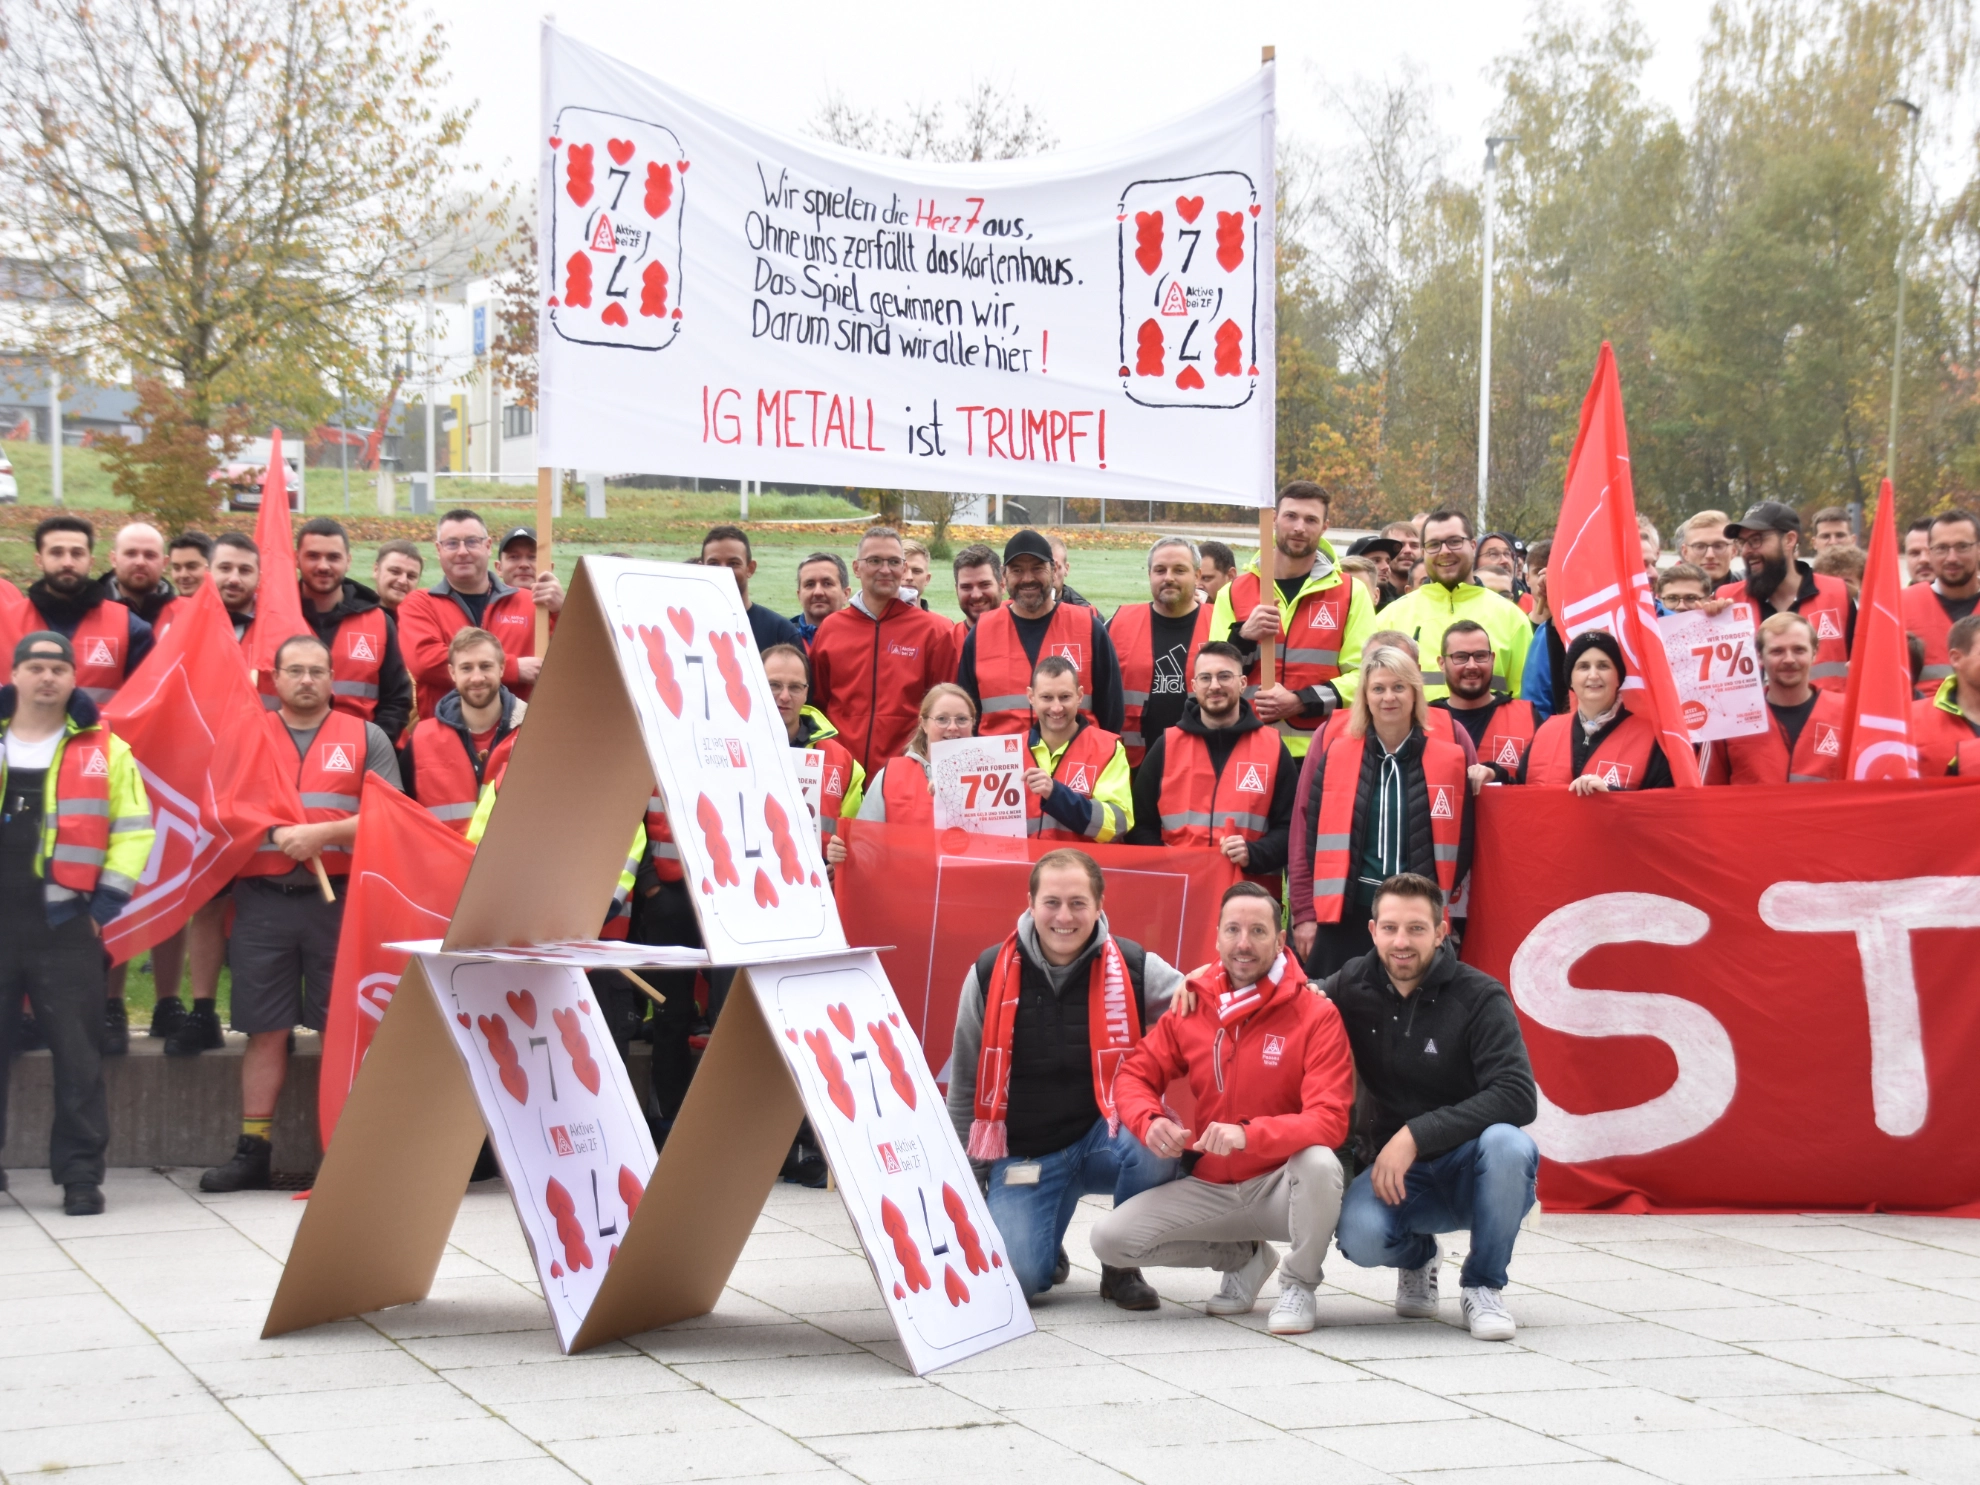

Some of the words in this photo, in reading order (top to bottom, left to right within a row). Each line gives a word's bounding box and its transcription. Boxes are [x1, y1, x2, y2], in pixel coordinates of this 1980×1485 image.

[607, 166, 631, 211] 7
[757, 161, 800, 209] Wir
[803, 186, 876, 232] spielen
[882, 193, 909, 226] die
[915, 198, 961, 233] Herz
[965, 197, 984, 234] 7
[982, 218, 1033, 240] aus,
[614, 236, 628, 247] bei
[629, 236, 641, 248] ZF
[615, 224, 642, 239] Aktive
[745, 211, 800, 258] Ohne
[804, 234, 838, 265] uns
[843, 229, 919, 272] zerfällt
[927, 234, 958, 274] das
[962, 242, 1084, 285] Kartenhaus.
[1178, 229, 1201, 273] 7
[606, 255, 629, 298] 7
[754, 256, 796, 296] Das
[801, 264, 865, 312] Spiel
[870, 285, 962, 328] gewinnen
[972, 292, 1020, 336] wir,
[1185, 286, 1214, 297] Aktive
[1186, 298, 1199, 308] bei
[1200, 298, 1212, 307] ZF
[752, 299, 829, 346] Darum
[834, 313, 891, 356] sind
[898, 327, 932, 359] wir
[933, 330, 979, 367] alle
[1179, 319, 1201, 361] 7
[703, 385, 742, 445] IG
[757, 388, 886, 451] METALL
[905, 398, 946, 457] ist
[956, 405, 1107, 470] TRUMPF!
[1691, 641, 1754, 682] 7%
[685, 655, 710, 721] 7
[960, 772, 1020, 809] 7%
[529, 1036, 558, 1101] 7
[850, 1050, 882, 1117] 7
[569, 1122, 595, 1137] Aktive
[574, 1140, 588, 1153] bei
[588, 1138, 597, 1151] ZF
[894, 1138, 917, 1153] Aktive
[900, 1156, 913, 1171] bei
[912, 1154, 921, 1168] ZF
